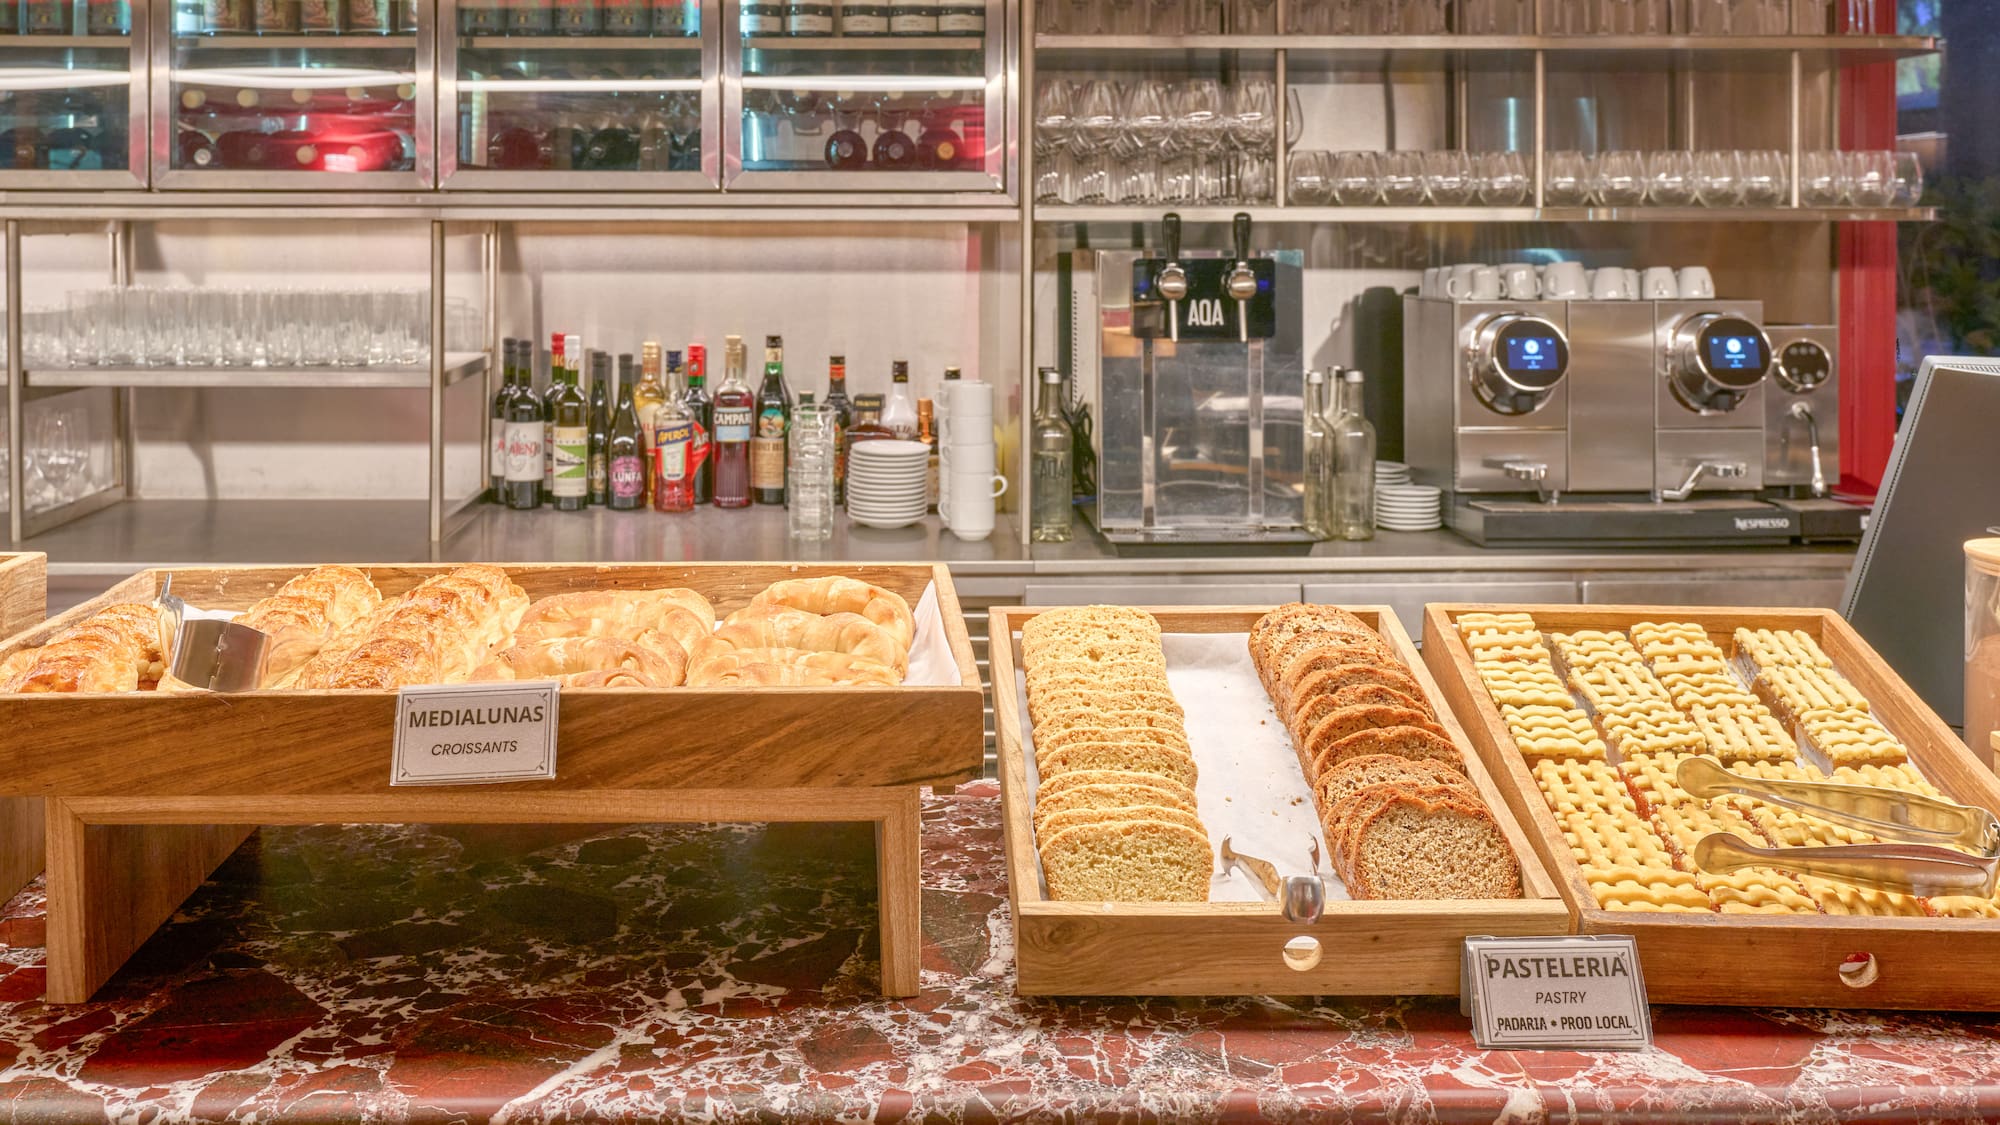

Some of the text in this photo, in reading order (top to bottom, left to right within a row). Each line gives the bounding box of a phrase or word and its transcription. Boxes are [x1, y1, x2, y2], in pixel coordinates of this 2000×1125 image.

[1187, 299, 1224, 326] AQA
[656, 428, 690, 443] APEROL
[612, 471, 643, 482] LUNFA
[1733, 517, 1790, 531] NESPRESSO
[409, 705, 544, 728] MEDIALUNAS
[431, 740, 518, 756] CROISSANTS
[1487, 956, 1629, 979] PASTELERIA
[1535, 991, 1587, 1004] PASTRY
[1497, 1016, 1633, 1031] PADARIA PROD LOCAL
